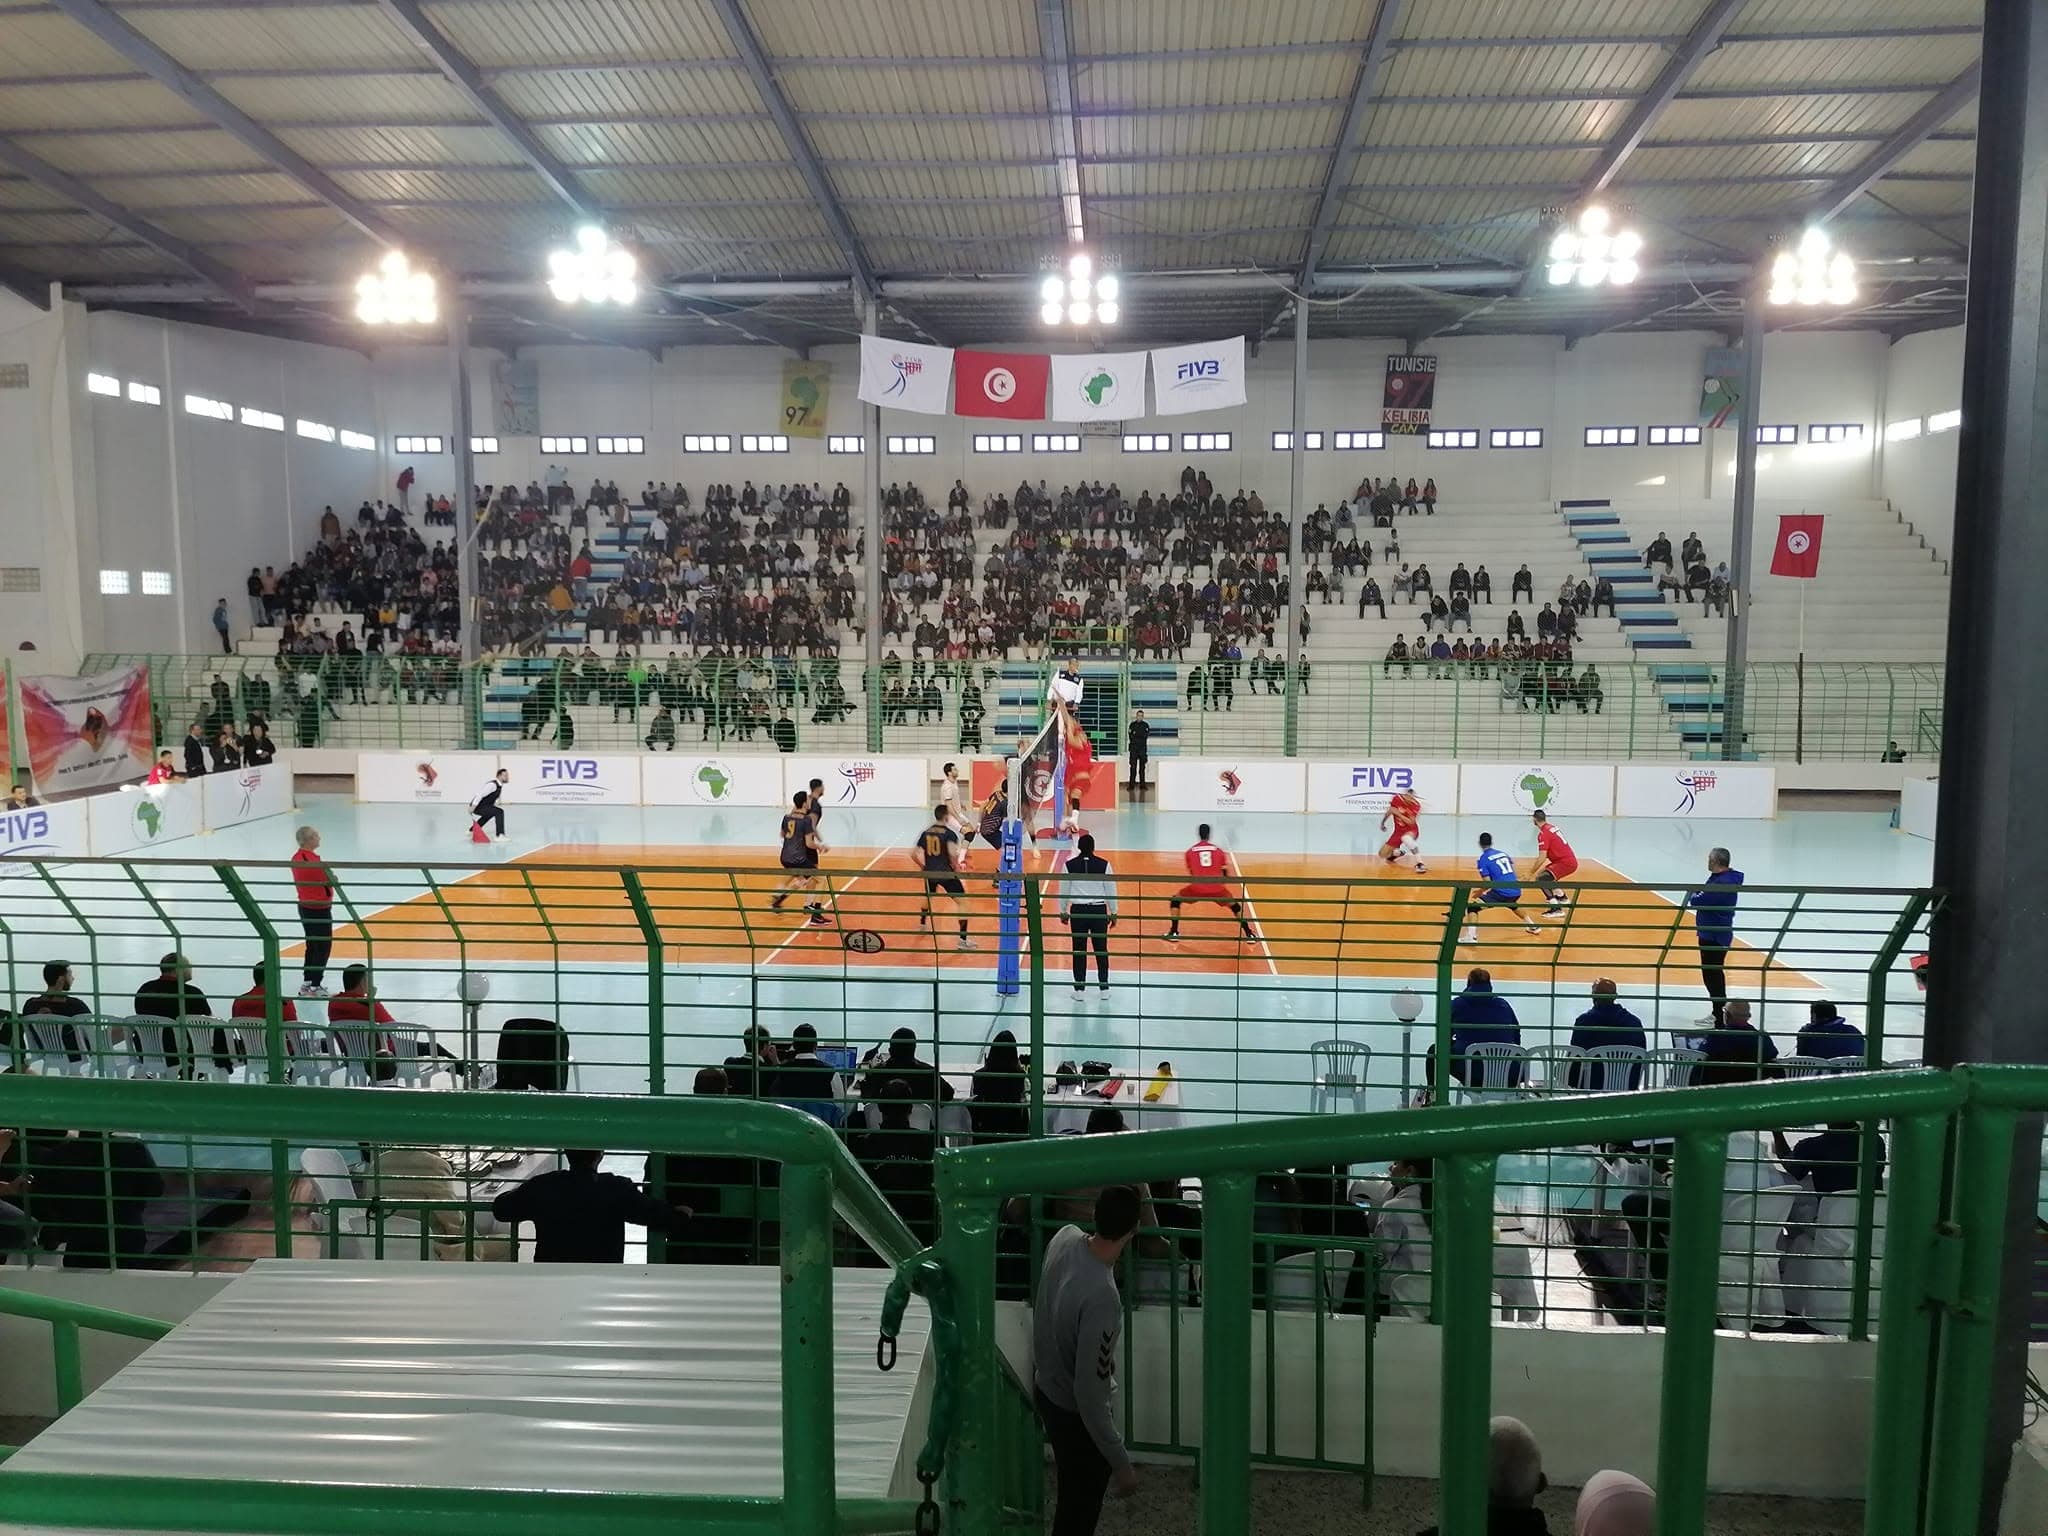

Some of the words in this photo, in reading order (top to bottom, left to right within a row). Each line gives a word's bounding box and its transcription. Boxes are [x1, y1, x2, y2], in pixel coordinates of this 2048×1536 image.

[1177, 360, 1219, 379] FIVB
[1387, 356, 1436, 373] TUNISIE
[785, 406, 809, 426] 97
[1383, 409, 1431, 423] KELIBIA
[1391, 423, 1418, 434] CAN
[542, 759, 598, 779] FIVB
[1352, 767, 1413, 788] FIVB
[786, 820, 796, 839] 9
[925, 833, 940, 856] 10
[1495, 857, 1514, 875] 17
